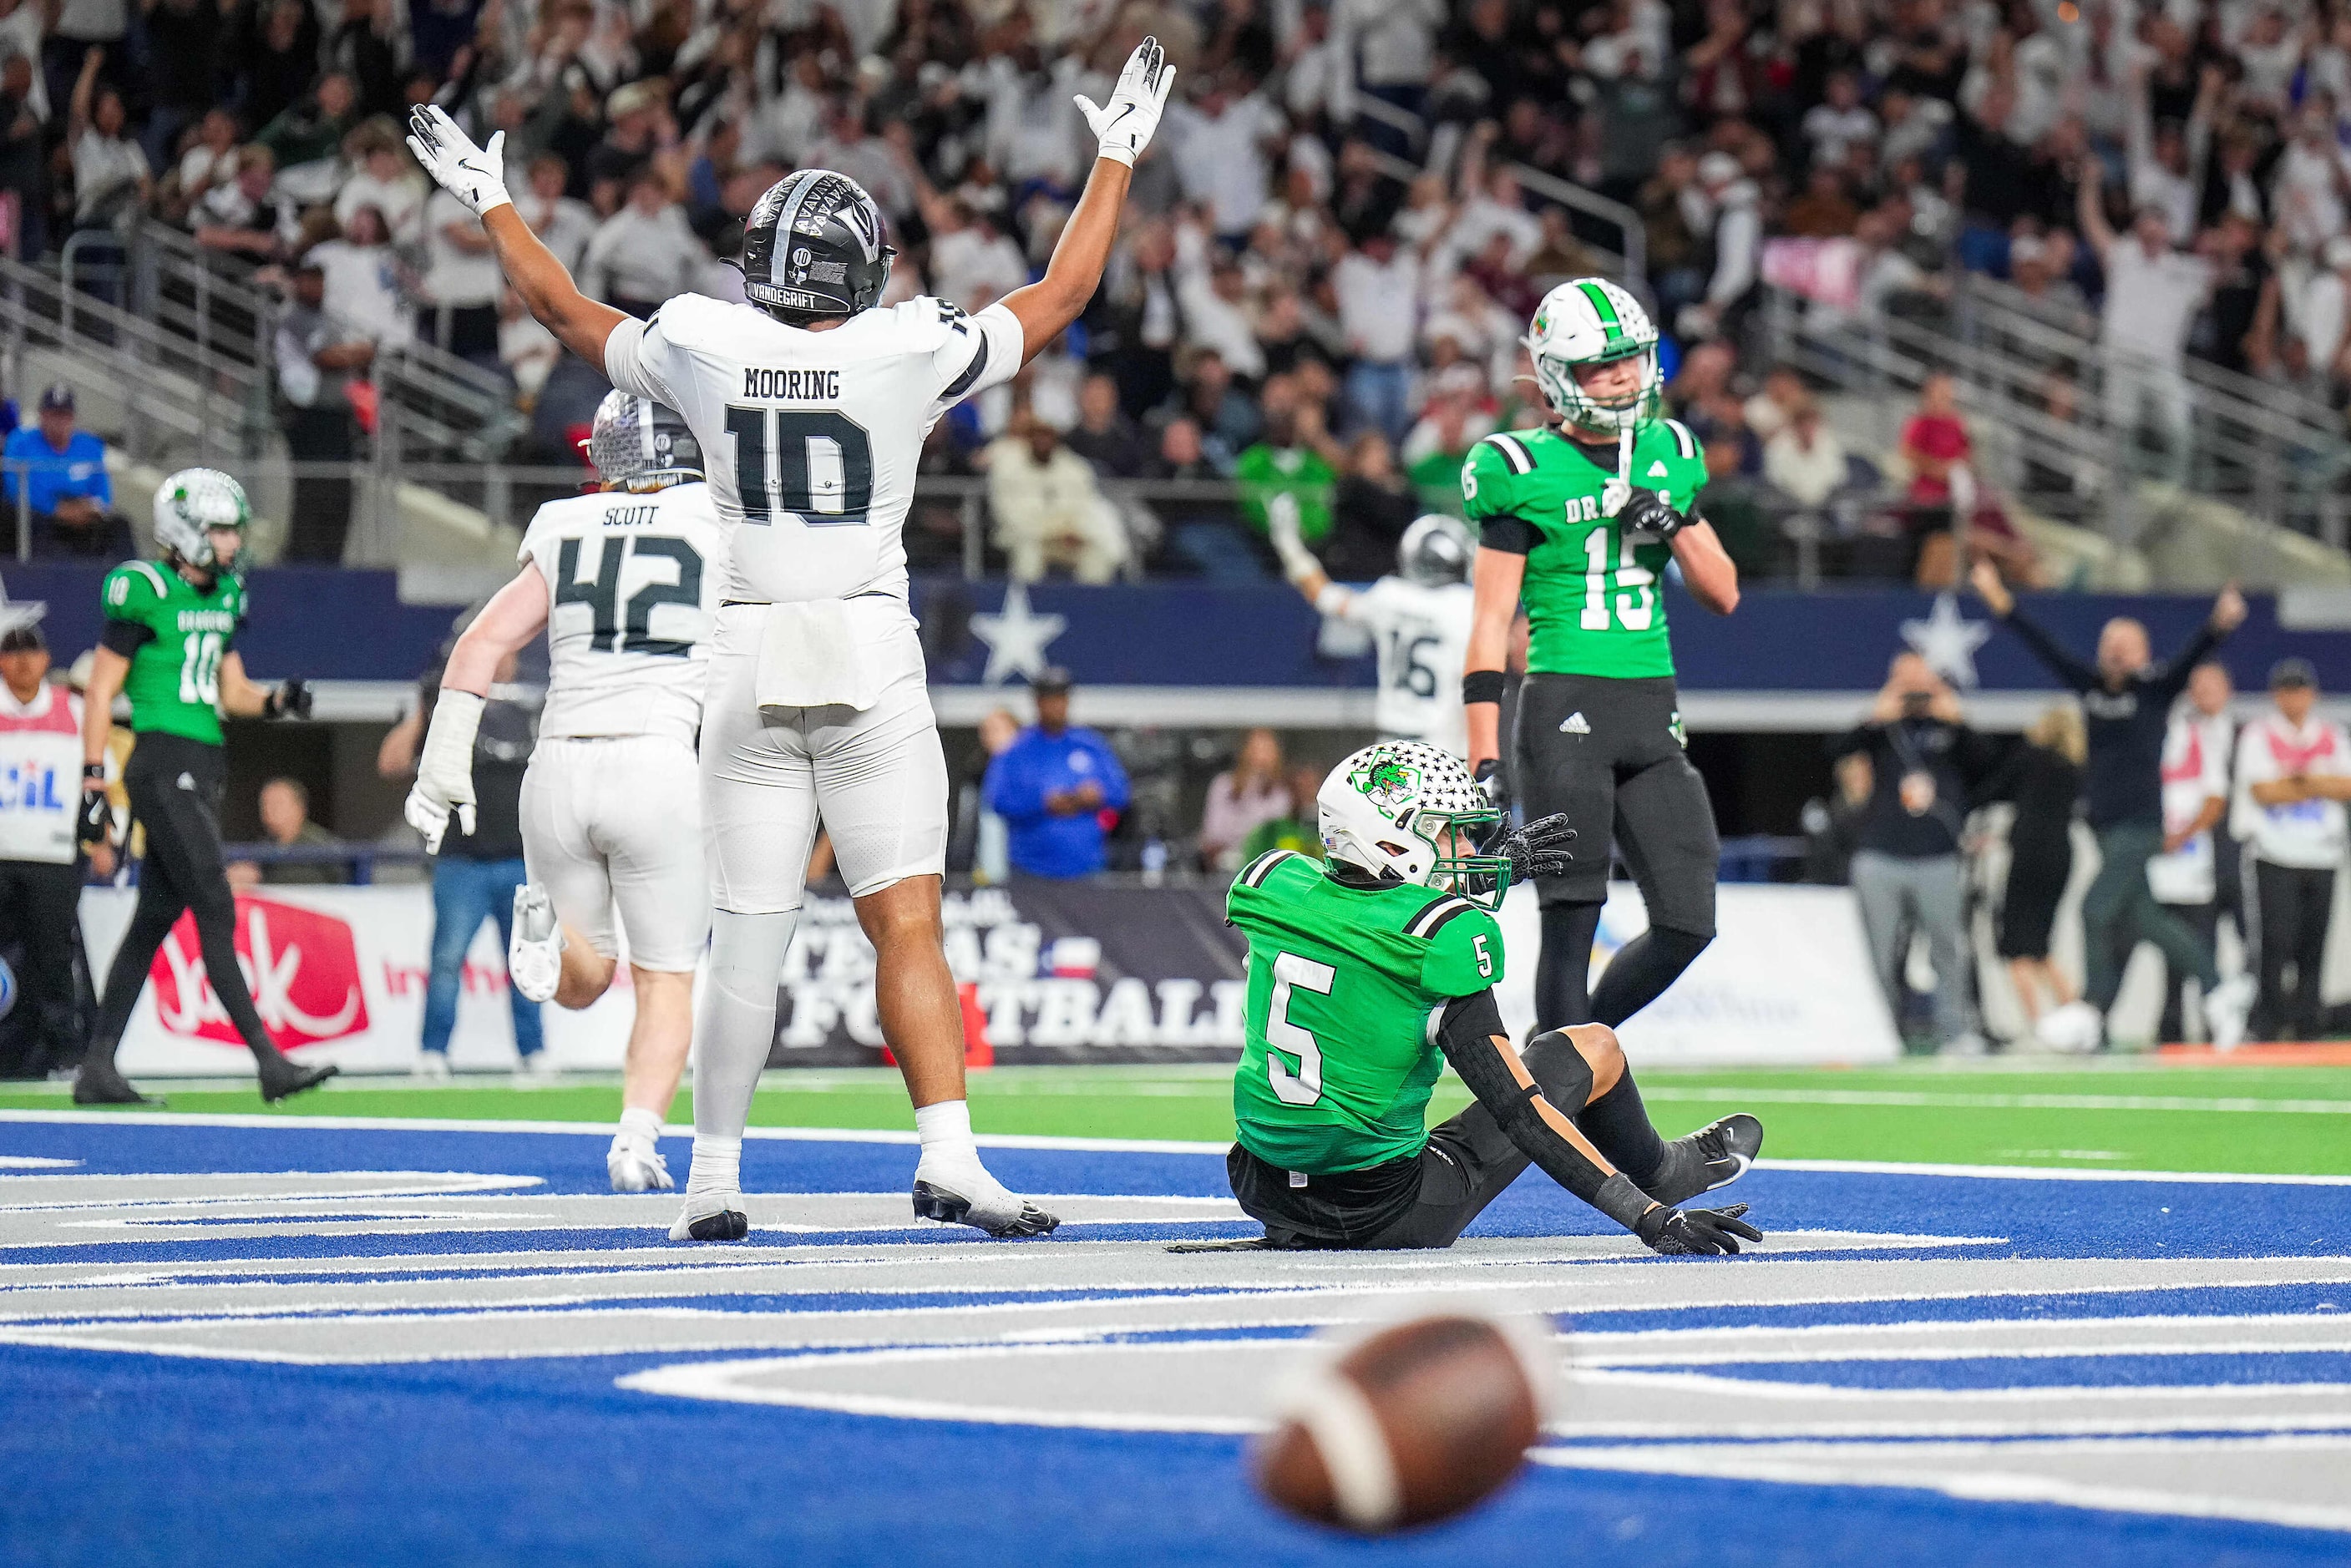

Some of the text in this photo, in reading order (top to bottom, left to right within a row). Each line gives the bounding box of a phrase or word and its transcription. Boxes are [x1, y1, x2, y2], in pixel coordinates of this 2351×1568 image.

[797, 250, 808, 265] 10
[753, 282, 816, 310] VANDEGRIFT
[743, 367, 840, 400] MOORING
[723, 402, 875, 528] 10
[602, 505, 660, 526] SCOTT
[109, 575, 130, 606] 10
[554, 534, 706, 659] 42
[1580, 525, 1656, 631] 15
[179, 632, 222, 705] 10
[782, 923, 1040, 982] TEAS
[1470, 933, 1493, 979] 5
[780, 979, 1250, 1045] FOTBALL
[1264, 950, 1338, 1107] 5
